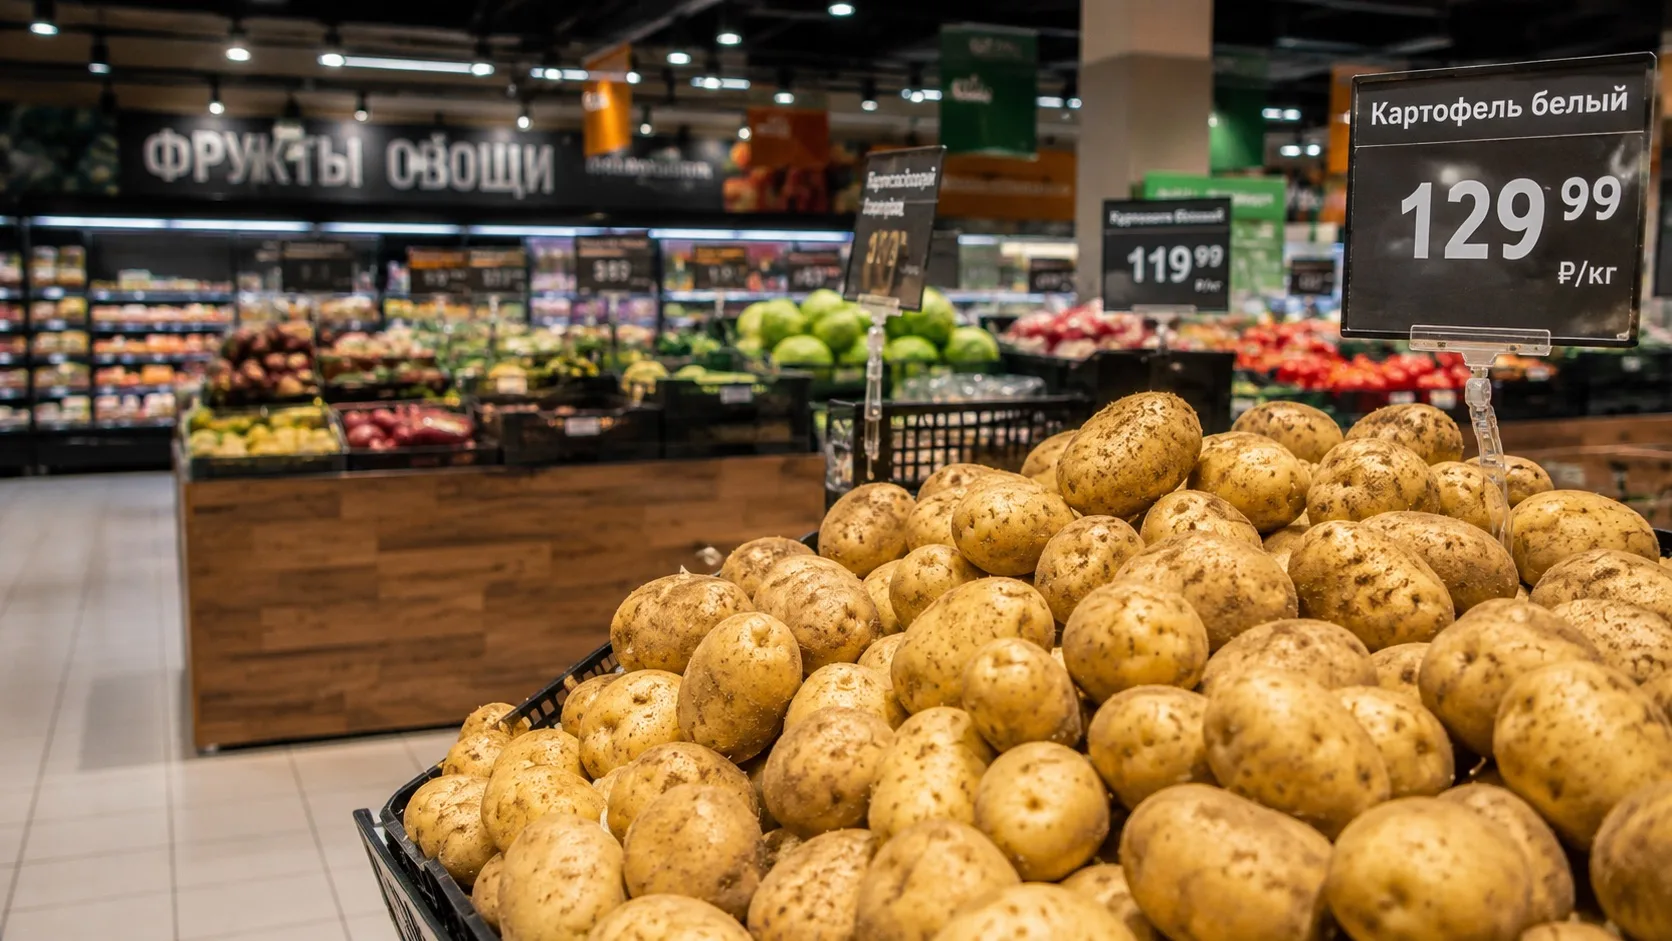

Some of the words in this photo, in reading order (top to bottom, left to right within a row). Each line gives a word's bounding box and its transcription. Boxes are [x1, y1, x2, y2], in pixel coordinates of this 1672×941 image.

[1371, 97, 1522, 129] Картофель
[1532, 85, 1628, 116] белый
[143, 127, 364, 188] ФРУКТЫ
[385, 138, 556, 199] ОВОЩИ
[1401, 177, 1545, 260] 129
[1560, 175, 1622, 221] 99
[1127, 245, 1192, 283] 119
[1194, 244, 1224, 268] 99
[1558, 260, 1618, 287] ₽/кг
